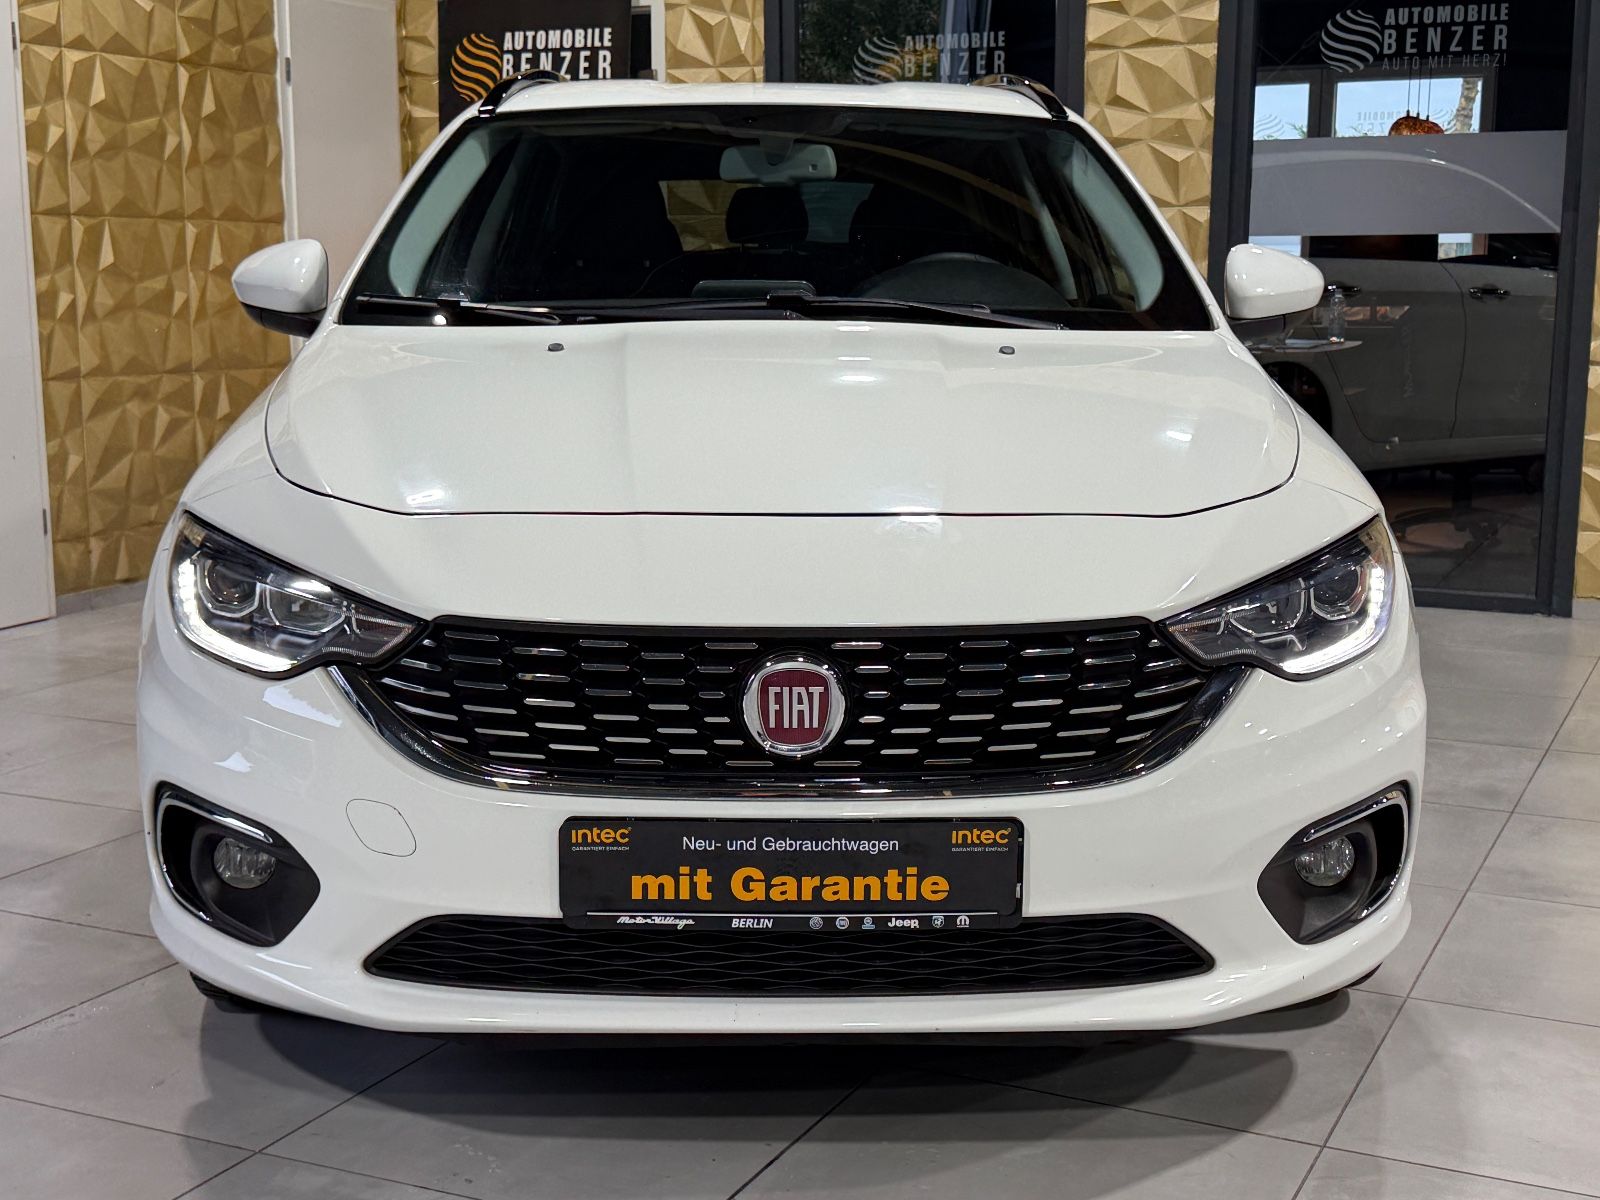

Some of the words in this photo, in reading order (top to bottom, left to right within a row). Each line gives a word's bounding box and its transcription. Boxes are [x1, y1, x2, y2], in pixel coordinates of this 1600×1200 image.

[1384, 3, 1509, 26] AUTOMOBILE
[503, 27, 613, 51] AUTOMOBILE
[904, 31, 1006, 52] AUTOMOBILE
[1383, 24, 1508, 55] BENZER
[502, 50, 613, 80] BENZER
[904, 50, 1006, 78] BENZER
[1382, 56, 1420, 71] AUTO
[1428, 55, 1453, 69] MIT
[1462, 53, 1507, 68] HERZ!
[768, 686, 825, 729] FIAT
[682, 836, 722, 850] Neu-
[726, 837, 757, 851] und
[762, 836, 899, 854] Gebrauchtwagen
[631, 866, 713, 901] mit
[730, 866, 950, 902] Garantie
[731, 918, 773, 929] BERLIN
[887, 916, 919, 929] Jeep
